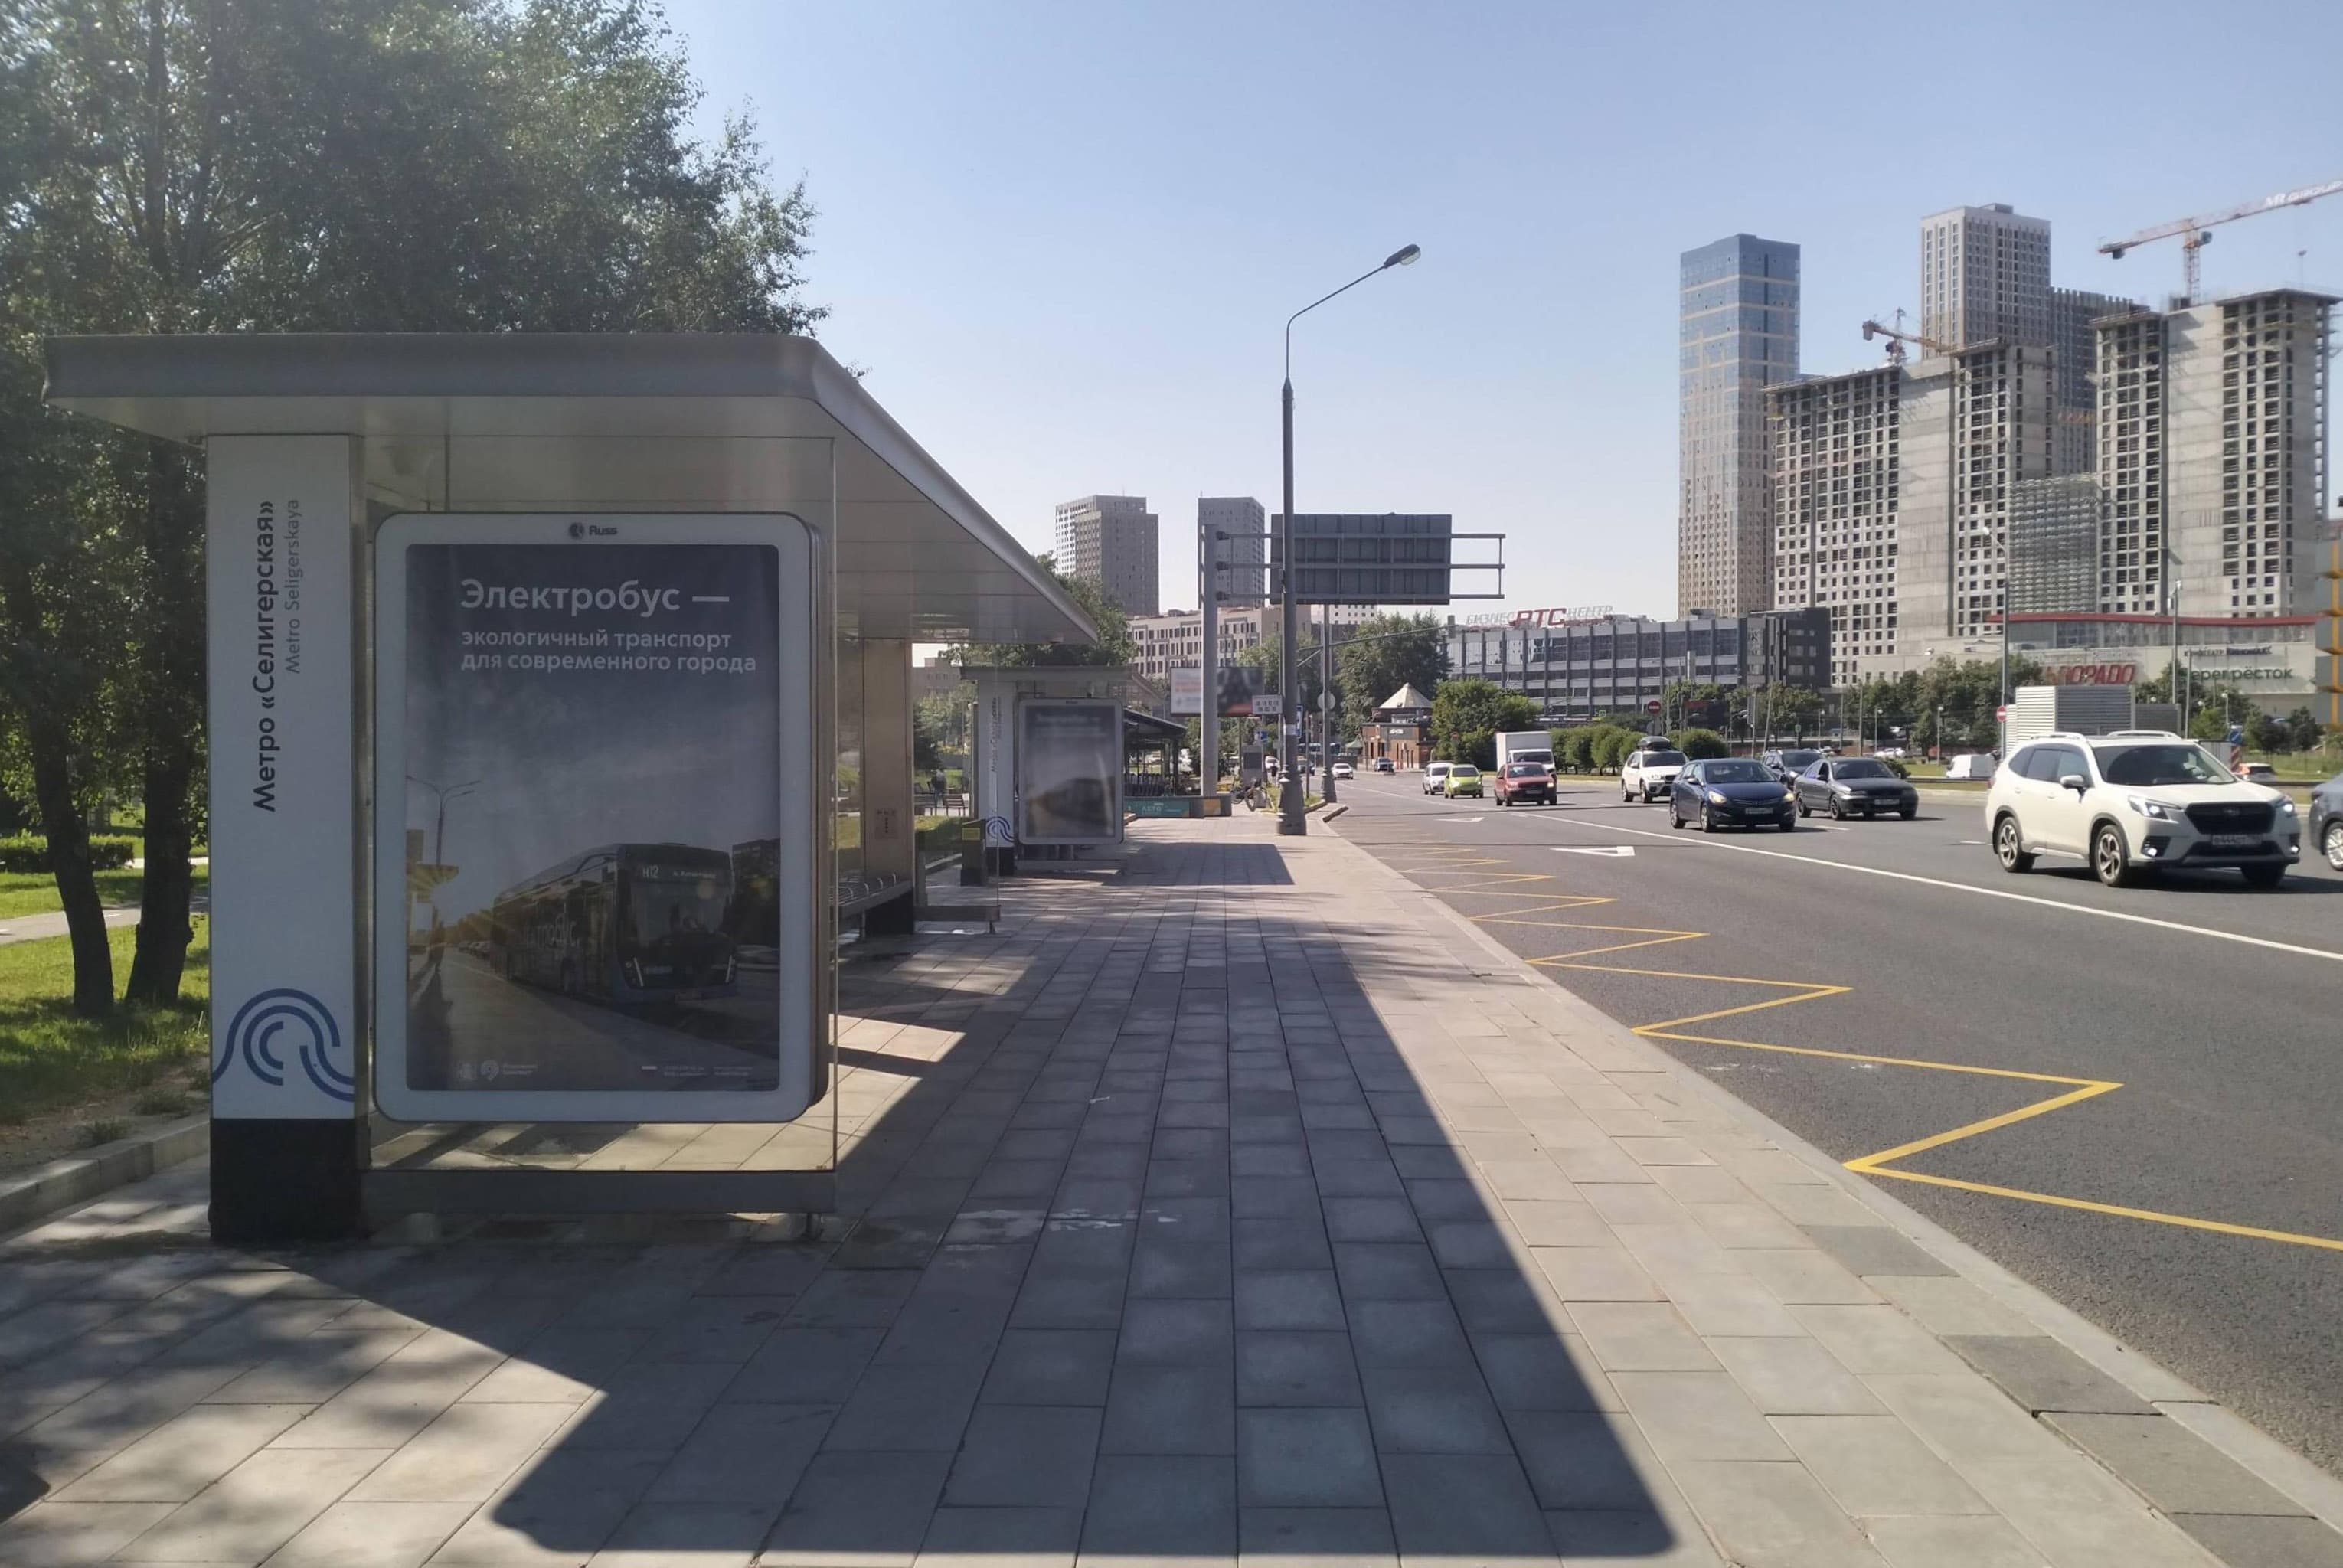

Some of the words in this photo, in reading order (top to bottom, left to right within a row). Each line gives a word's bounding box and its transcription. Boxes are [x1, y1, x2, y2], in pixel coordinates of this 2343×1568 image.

[589, 525, 619, 536] Russ
[284, 499, 304, 611] Seligerskaya
[253, 501, 279, 709] «Селигерская»
[460, 578, 681, 617] Электробус
[285, 618, 301, 674] Metro
[461, 629, 609, 647] экологичный
[614, 632, 732, 651] транспорт
[461, 654, 502, 671] для
[508, 655, 671, 673] современного
[678, 657, 756, 674] города
[2182, 665, 2293, 682] ерекрёсток
[253, 717, 280, 812] Метро
